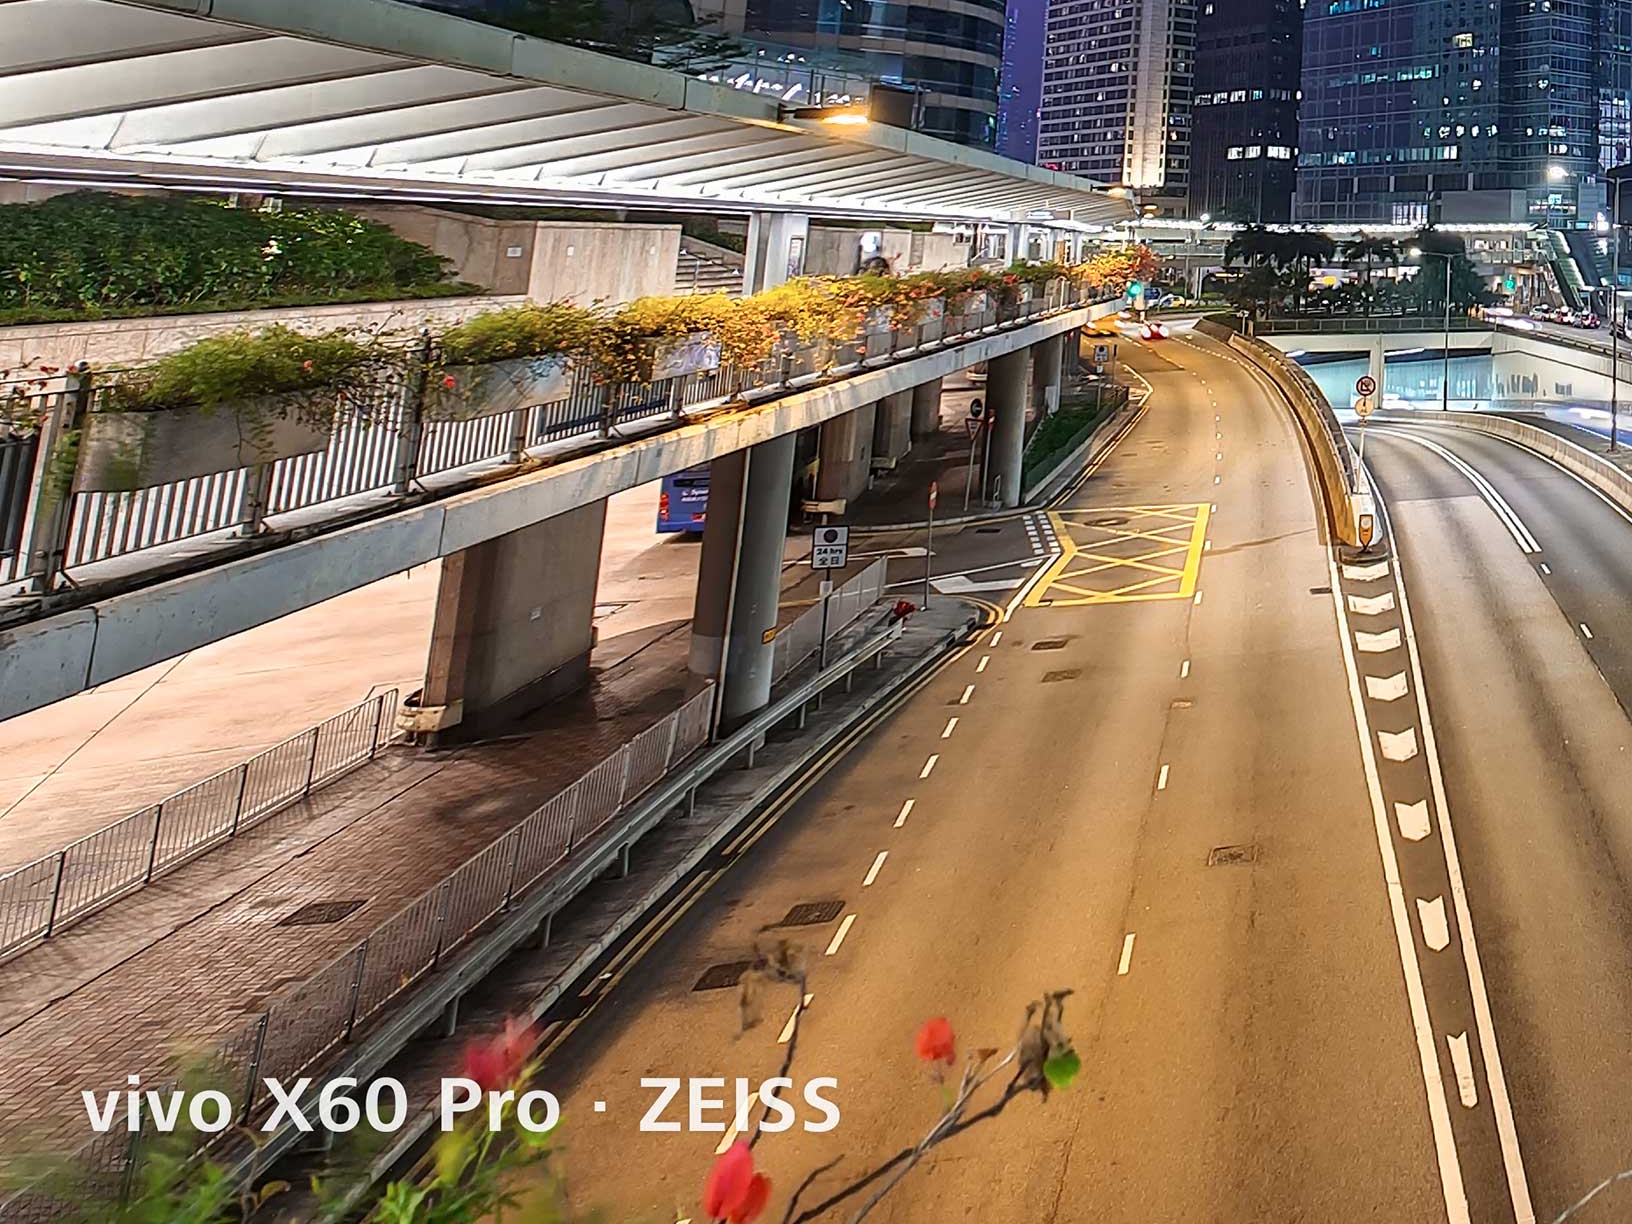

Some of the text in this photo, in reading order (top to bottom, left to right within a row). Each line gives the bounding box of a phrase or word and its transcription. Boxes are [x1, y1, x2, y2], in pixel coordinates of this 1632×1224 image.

[816, 547, 843, 556] 24 hrs
[818, 556, 840, 565] 全日
